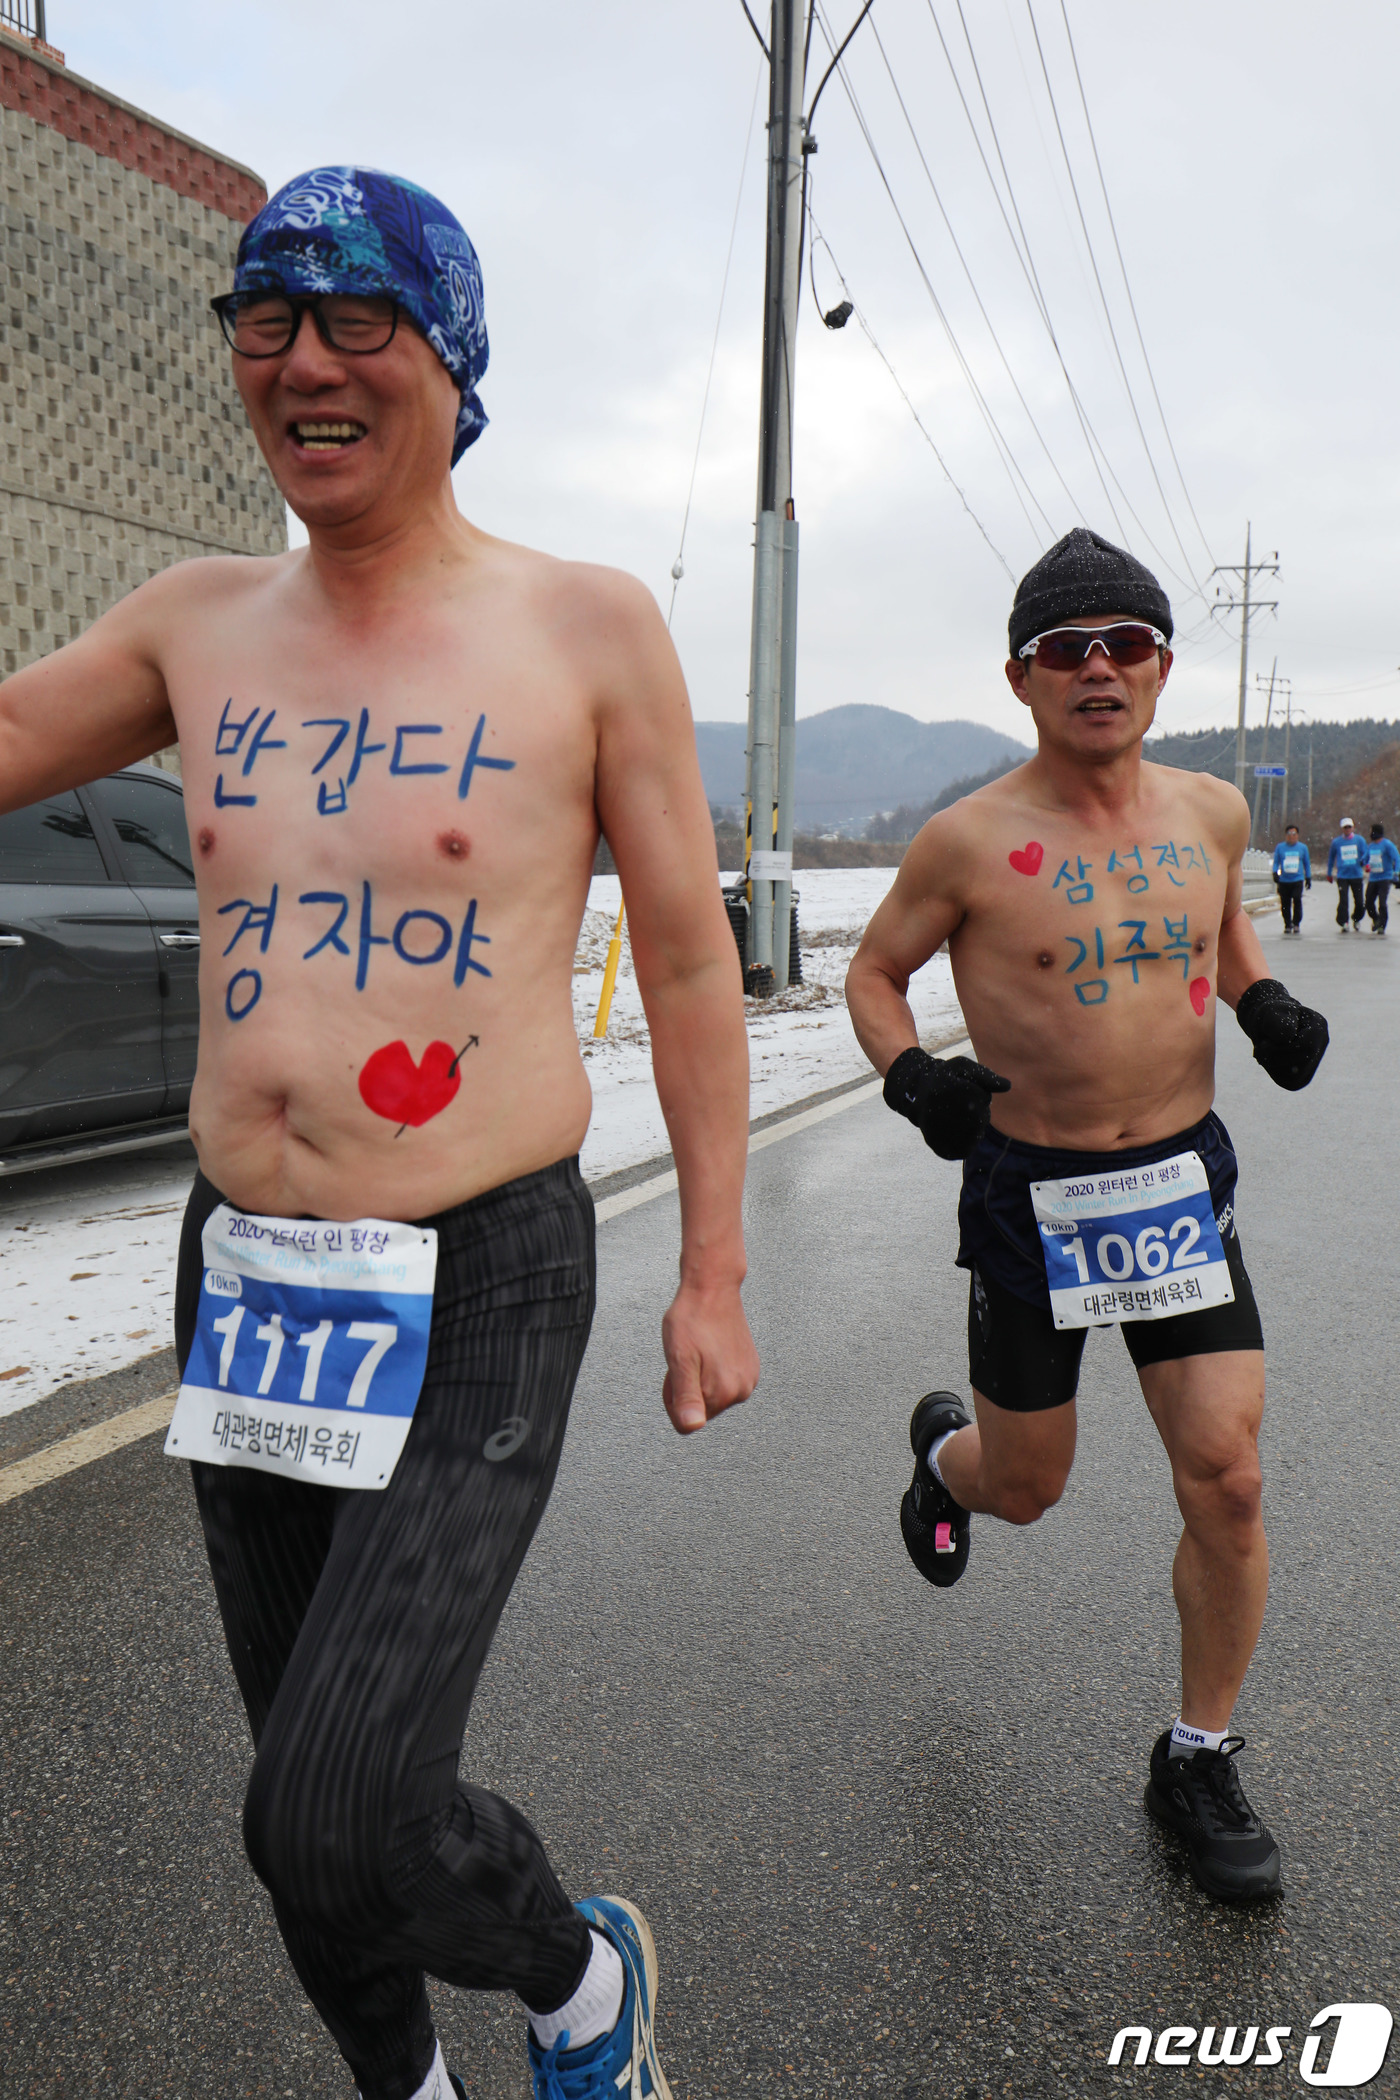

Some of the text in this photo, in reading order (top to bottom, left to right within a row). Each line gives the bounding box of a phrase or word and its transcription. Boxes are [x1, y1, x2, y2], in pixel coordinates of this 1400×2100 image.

[214, 697, 516, 815] 반갑다
[1052, 841, 1212, 905] 삼성전자
[217, 880, 493, 1022] 경자야
[1065, 914, 1193, 1006] 김주복
[1051, 1179, 1195, 1214] 2020 Winter Run In Pyeongchang
[1064, 1163, 1181, 1198] 2020 윈터런 인 평창
[1045, 1222, 1075, 1232] 10km
[1216, 1202, 1234, 1234] asics
[323, 1229, 343, 1252] 인
[350, 1228, 391, 1255] 평창
[1061, 1216, 1209, 1284] 1062
[274, 1250, 301, 1272] Run
[303, 1254, 318, 1273] In
[210, 1273, 239, 1293] 10km
[1083, 1277, 1203, 1316] 대관령면체육회
[212, 1305, 399, 1408] 1117
[212, 1411, 361, 1470] 대관령면체육회
[1174, 1727, 1206, 1744] TOUR
